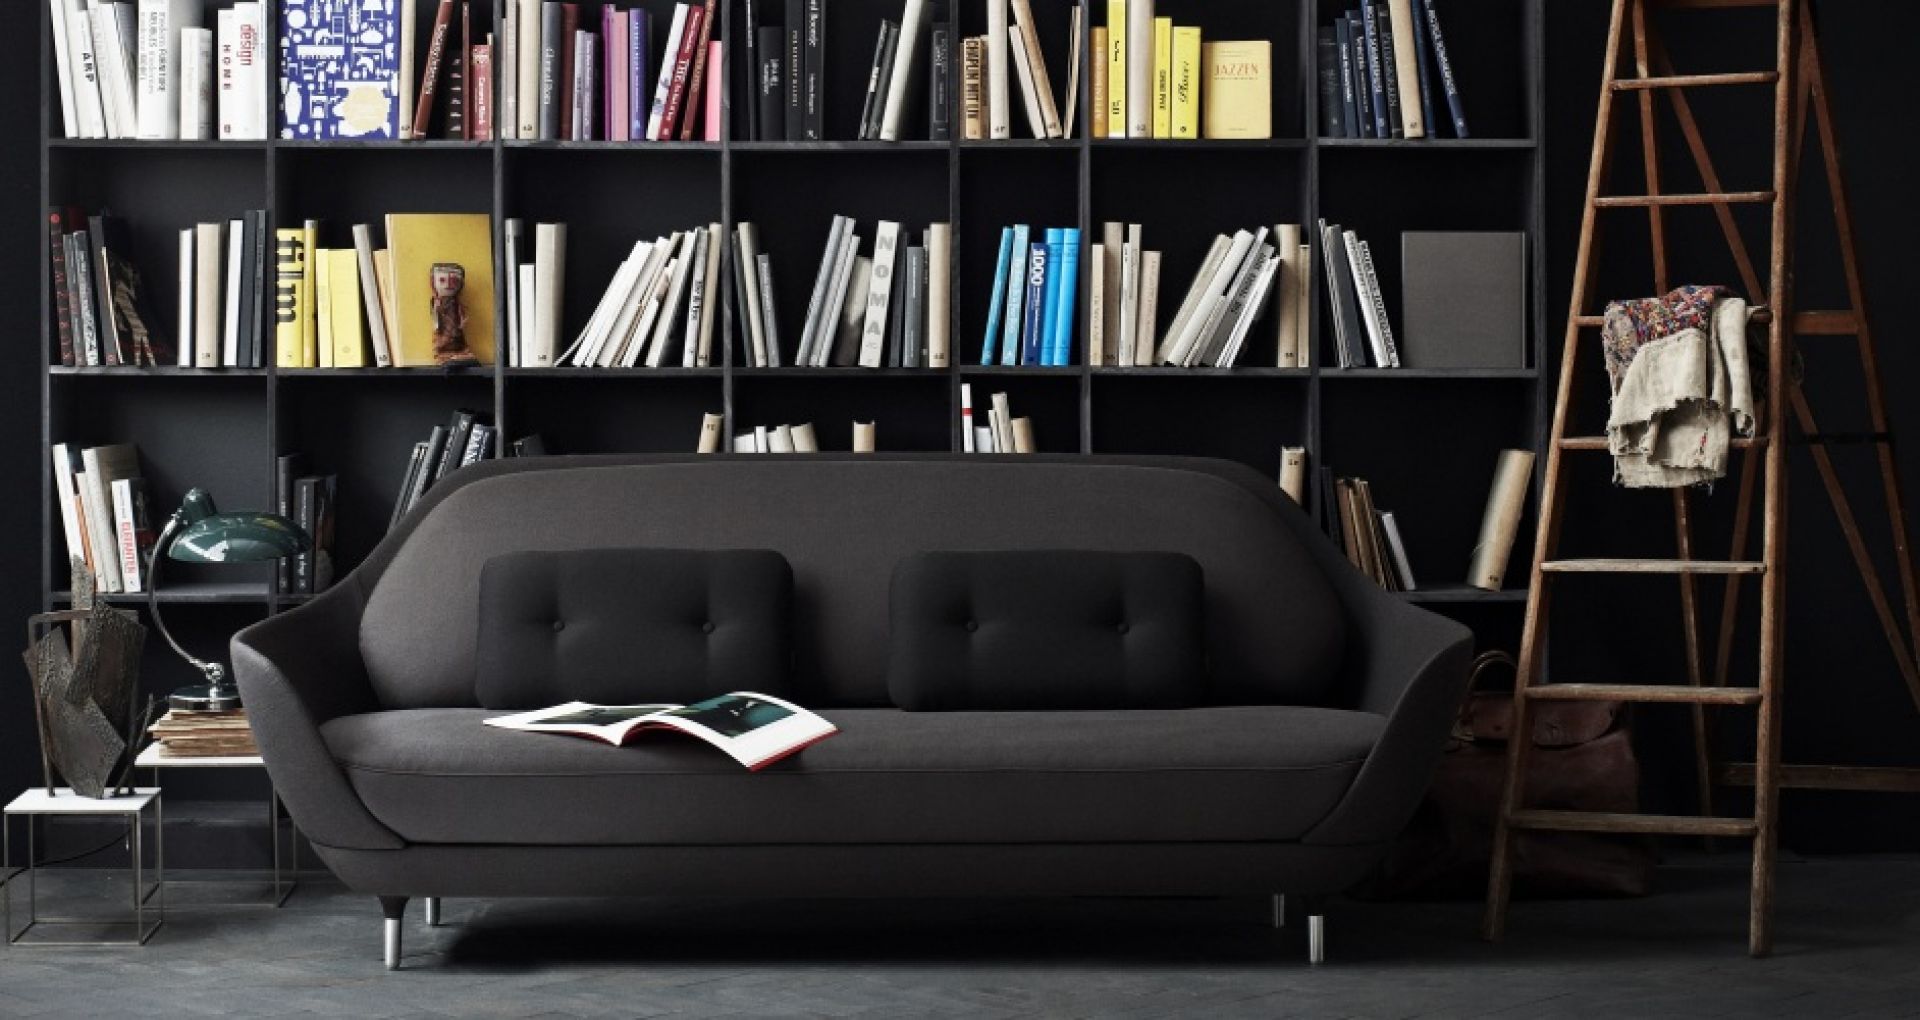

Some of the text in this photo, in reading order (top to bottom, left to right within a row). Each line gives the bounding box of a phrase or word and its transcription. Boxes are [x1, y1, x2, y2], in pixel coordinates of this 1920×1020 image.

[236, 23, 257, 67] design
[966, 40, 980, 81] CHAPLIN
[81, 52, 95, 83] ARP
[221, 44, 232, 91] HOME
[276, 235, 305, 326] film
[866, 235, 895, 336] NOMA
[1030, 247, 1047, 287] 1000
